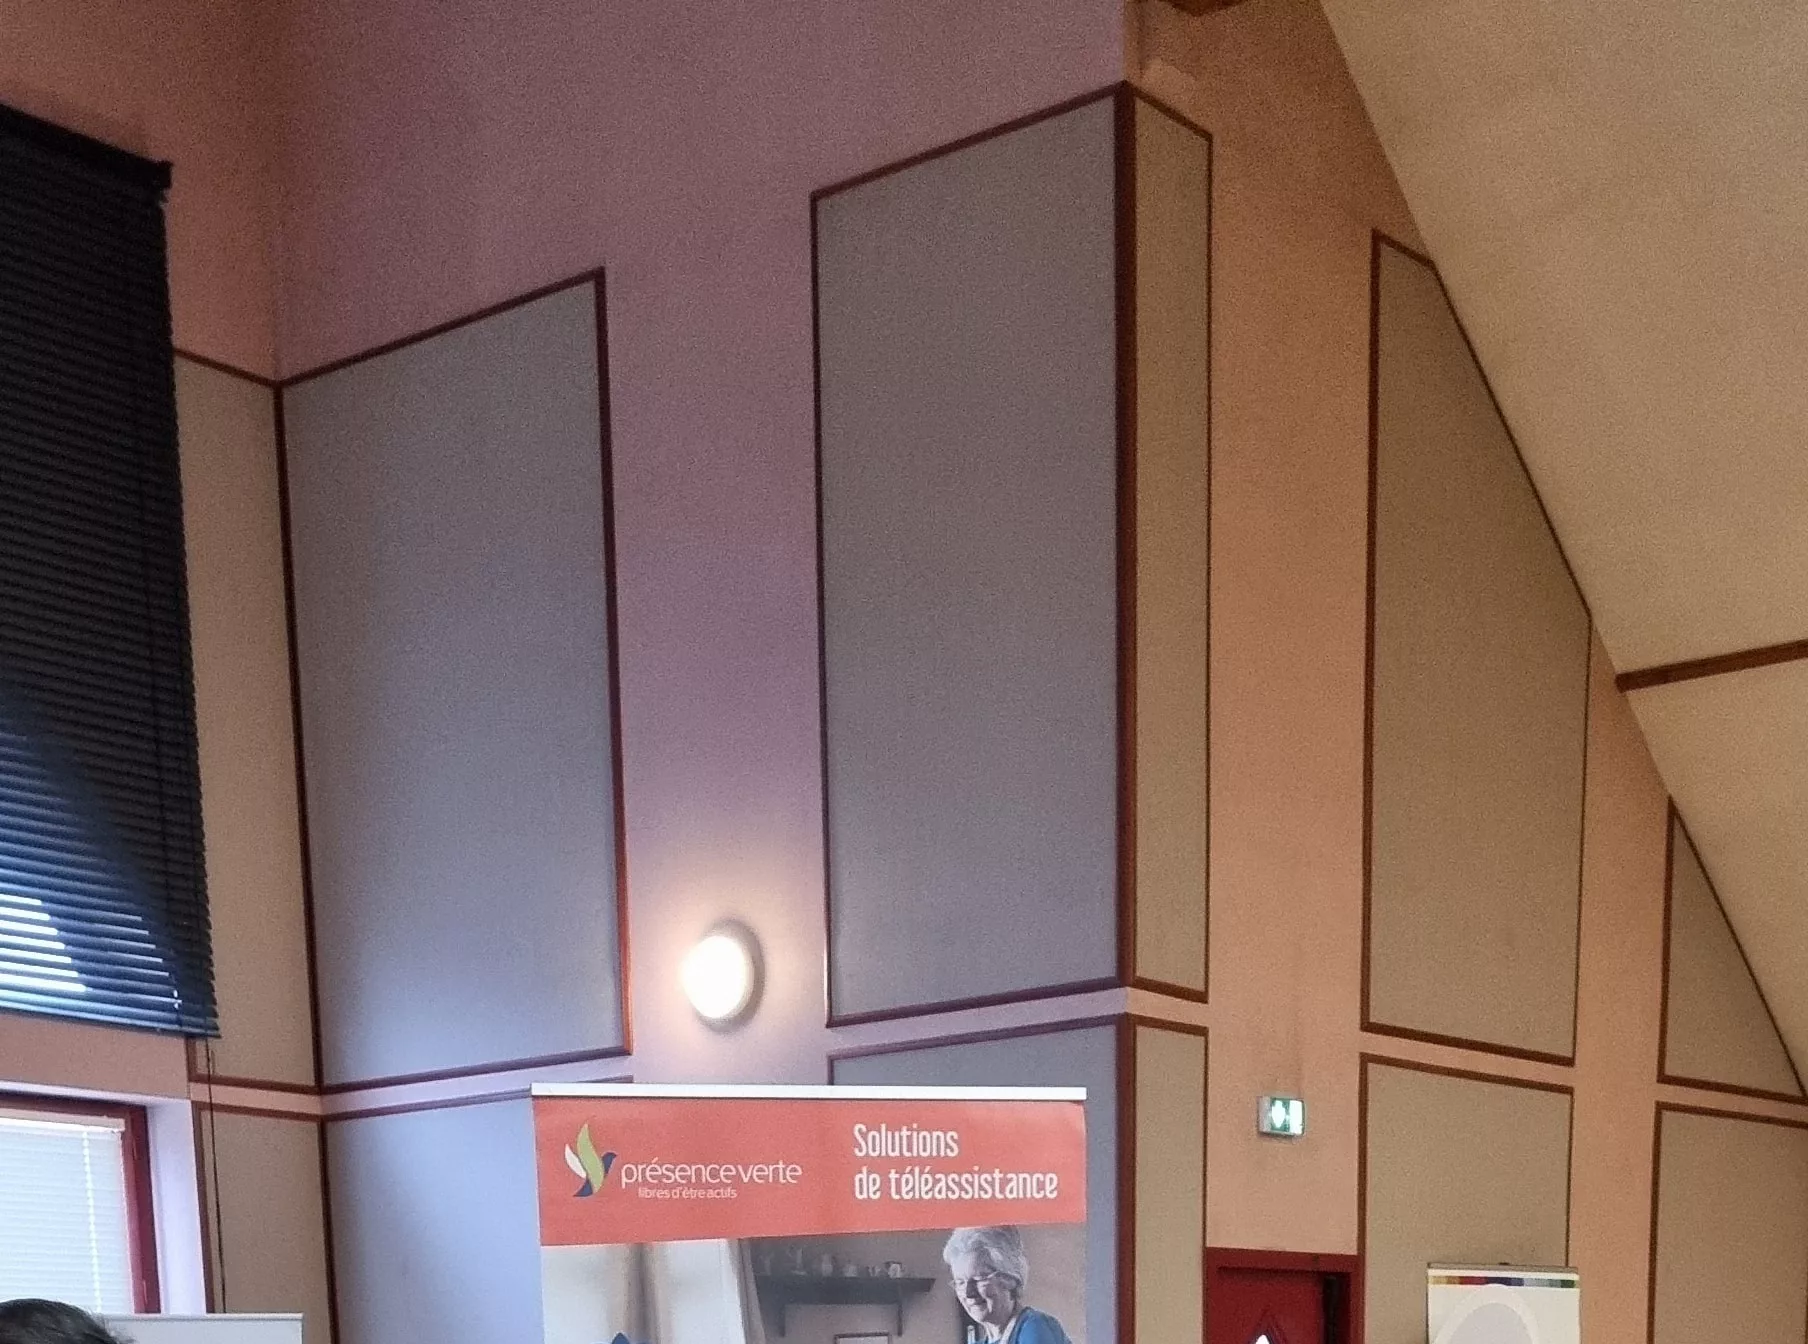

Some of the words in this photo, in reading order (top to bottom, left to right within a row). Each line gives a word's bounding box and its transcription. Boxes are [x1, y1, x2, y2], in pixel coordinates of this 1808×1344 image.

[853, 1123, 960, 1157] Solutions
[854, 1166, 881, 1200] de
[888, 1166, 1058, 1200] téléassistance
